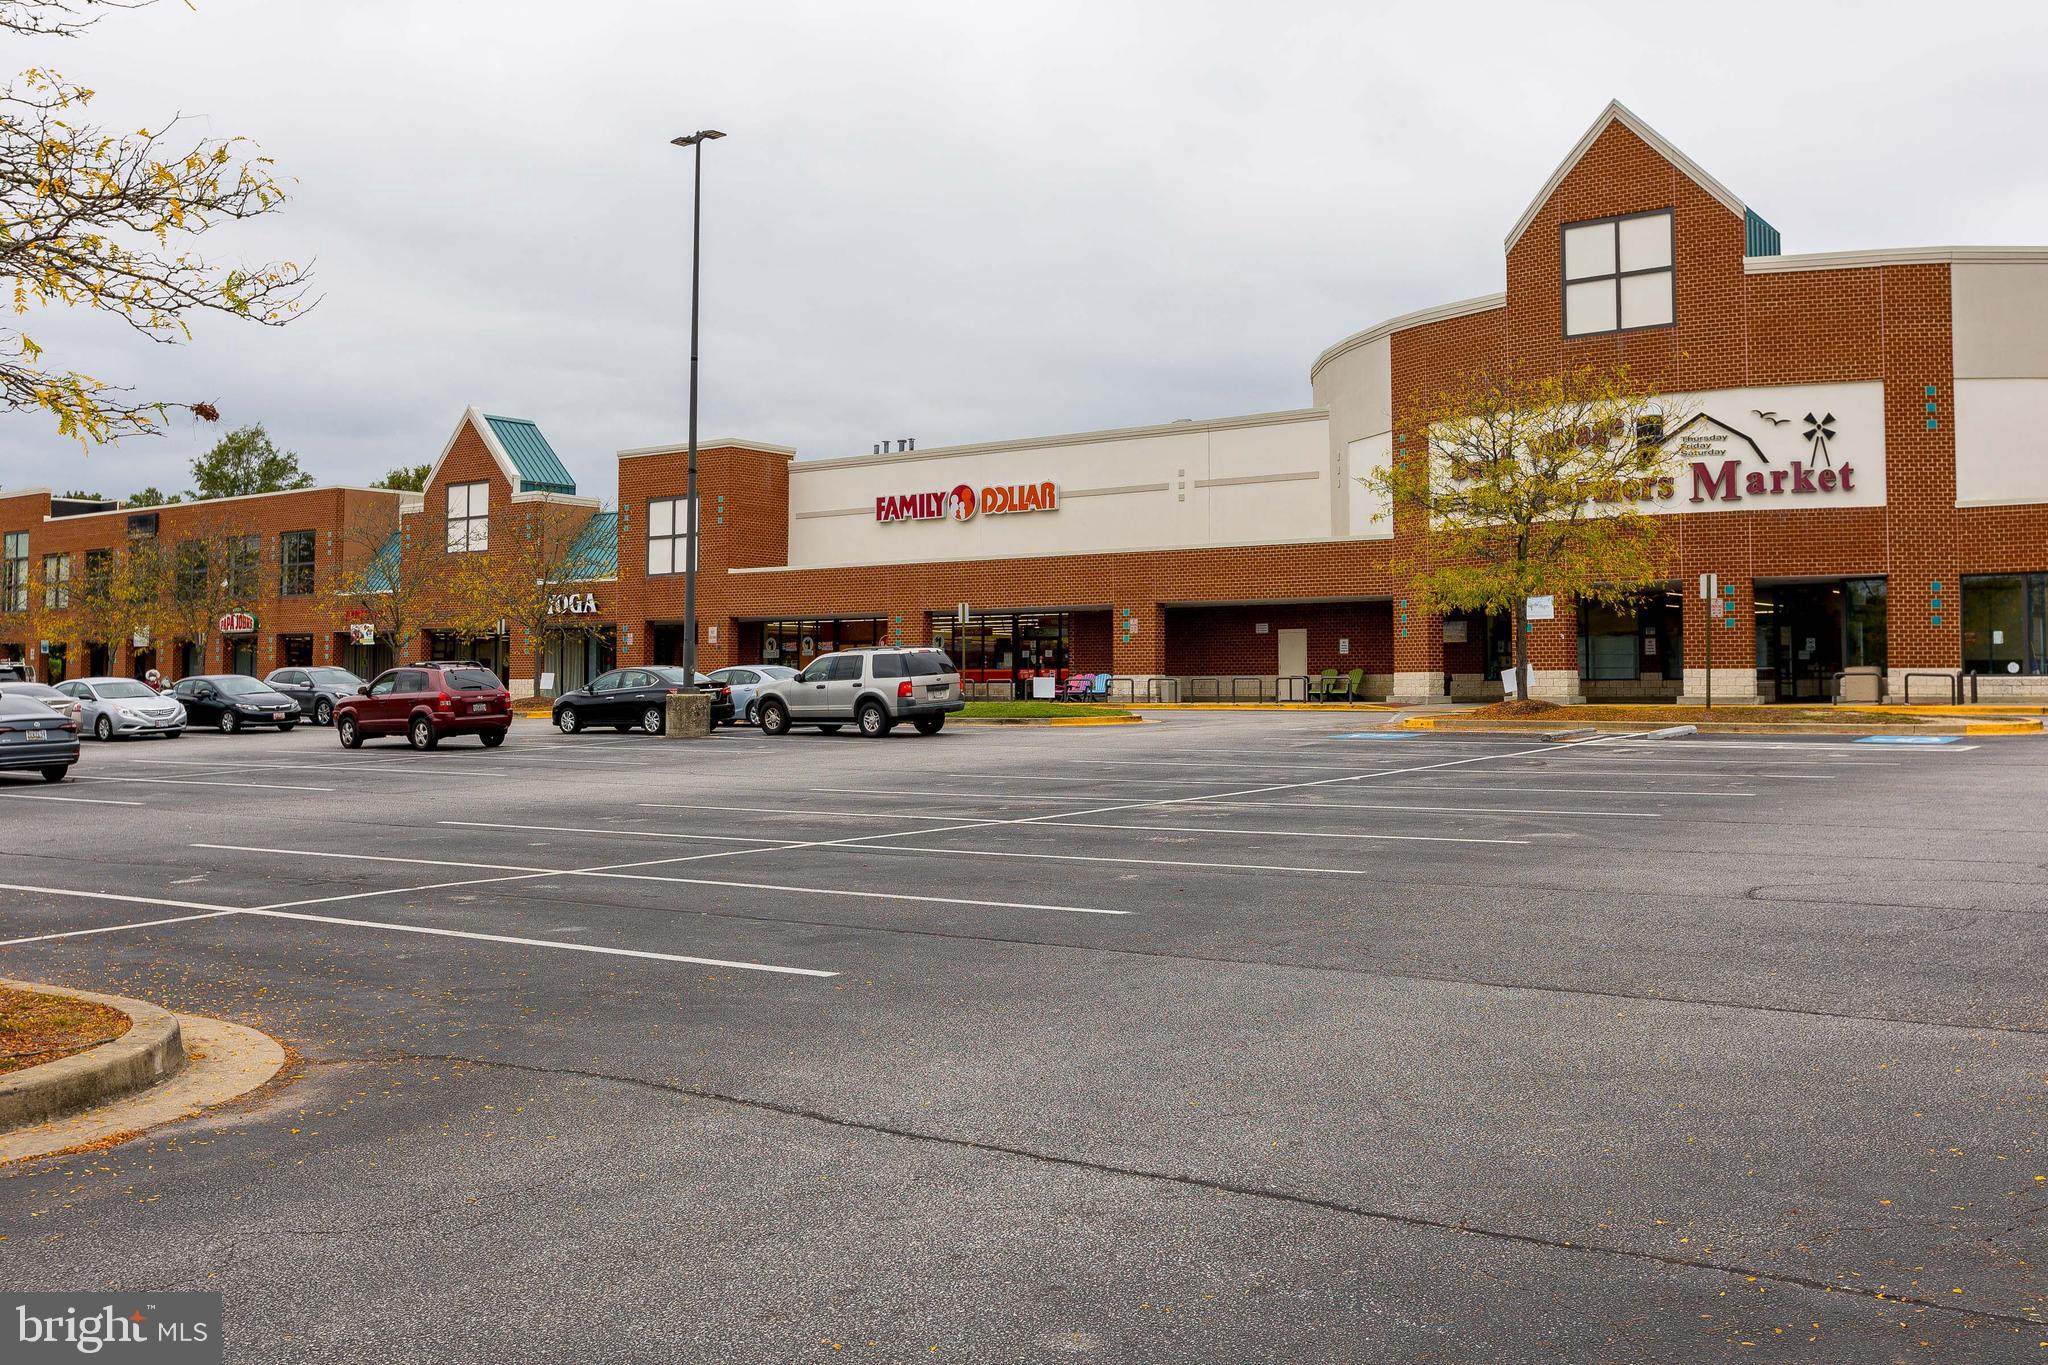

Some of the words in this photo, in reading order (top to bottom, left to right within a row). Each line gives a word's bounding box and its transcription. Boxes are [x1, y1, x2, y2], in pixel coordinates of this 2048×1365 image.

[1680, 434, 1728, 442] Thursday
[1680, 449, 1727, 457] Saturday
[1689, 460, 1855, 503] Market
[876, 491, 946, 522] FAMILY
[981, 481, 1057, 514] DOLLAR
[221, 615, 235, 630] PAPA
